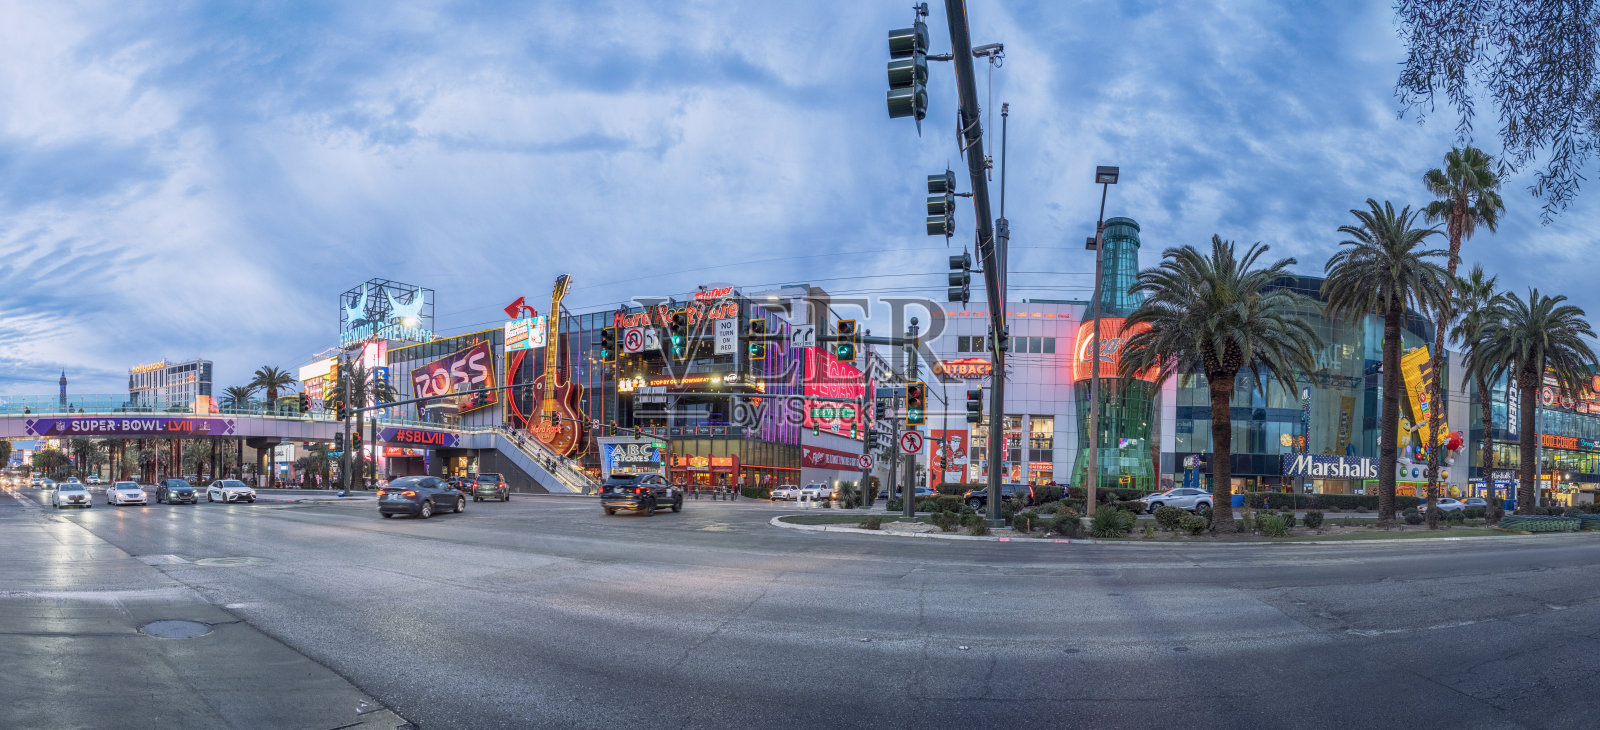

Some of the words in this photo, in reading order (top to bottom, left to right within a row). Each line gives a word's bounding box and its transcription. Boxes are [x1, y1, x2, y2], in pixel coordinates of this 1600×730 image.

[612, 306, 652, 328] Hard
[655, 302, 697, 327] Rok
[132, 359, 165, 374] hollywood
[933, 364, 992, 375] OUTBACK
[415, 352, 487, 399] ROSS
[72, 420, 116, 431] SUPER
[122, 420, 162, 431] BOWL
[168, 420, 192, 431] LVIII
[396, 430, 445, 445] #SBLVIII
[611, 444, 653, 457] ABC
[1288, 454, 1378, 478] Marshalls
